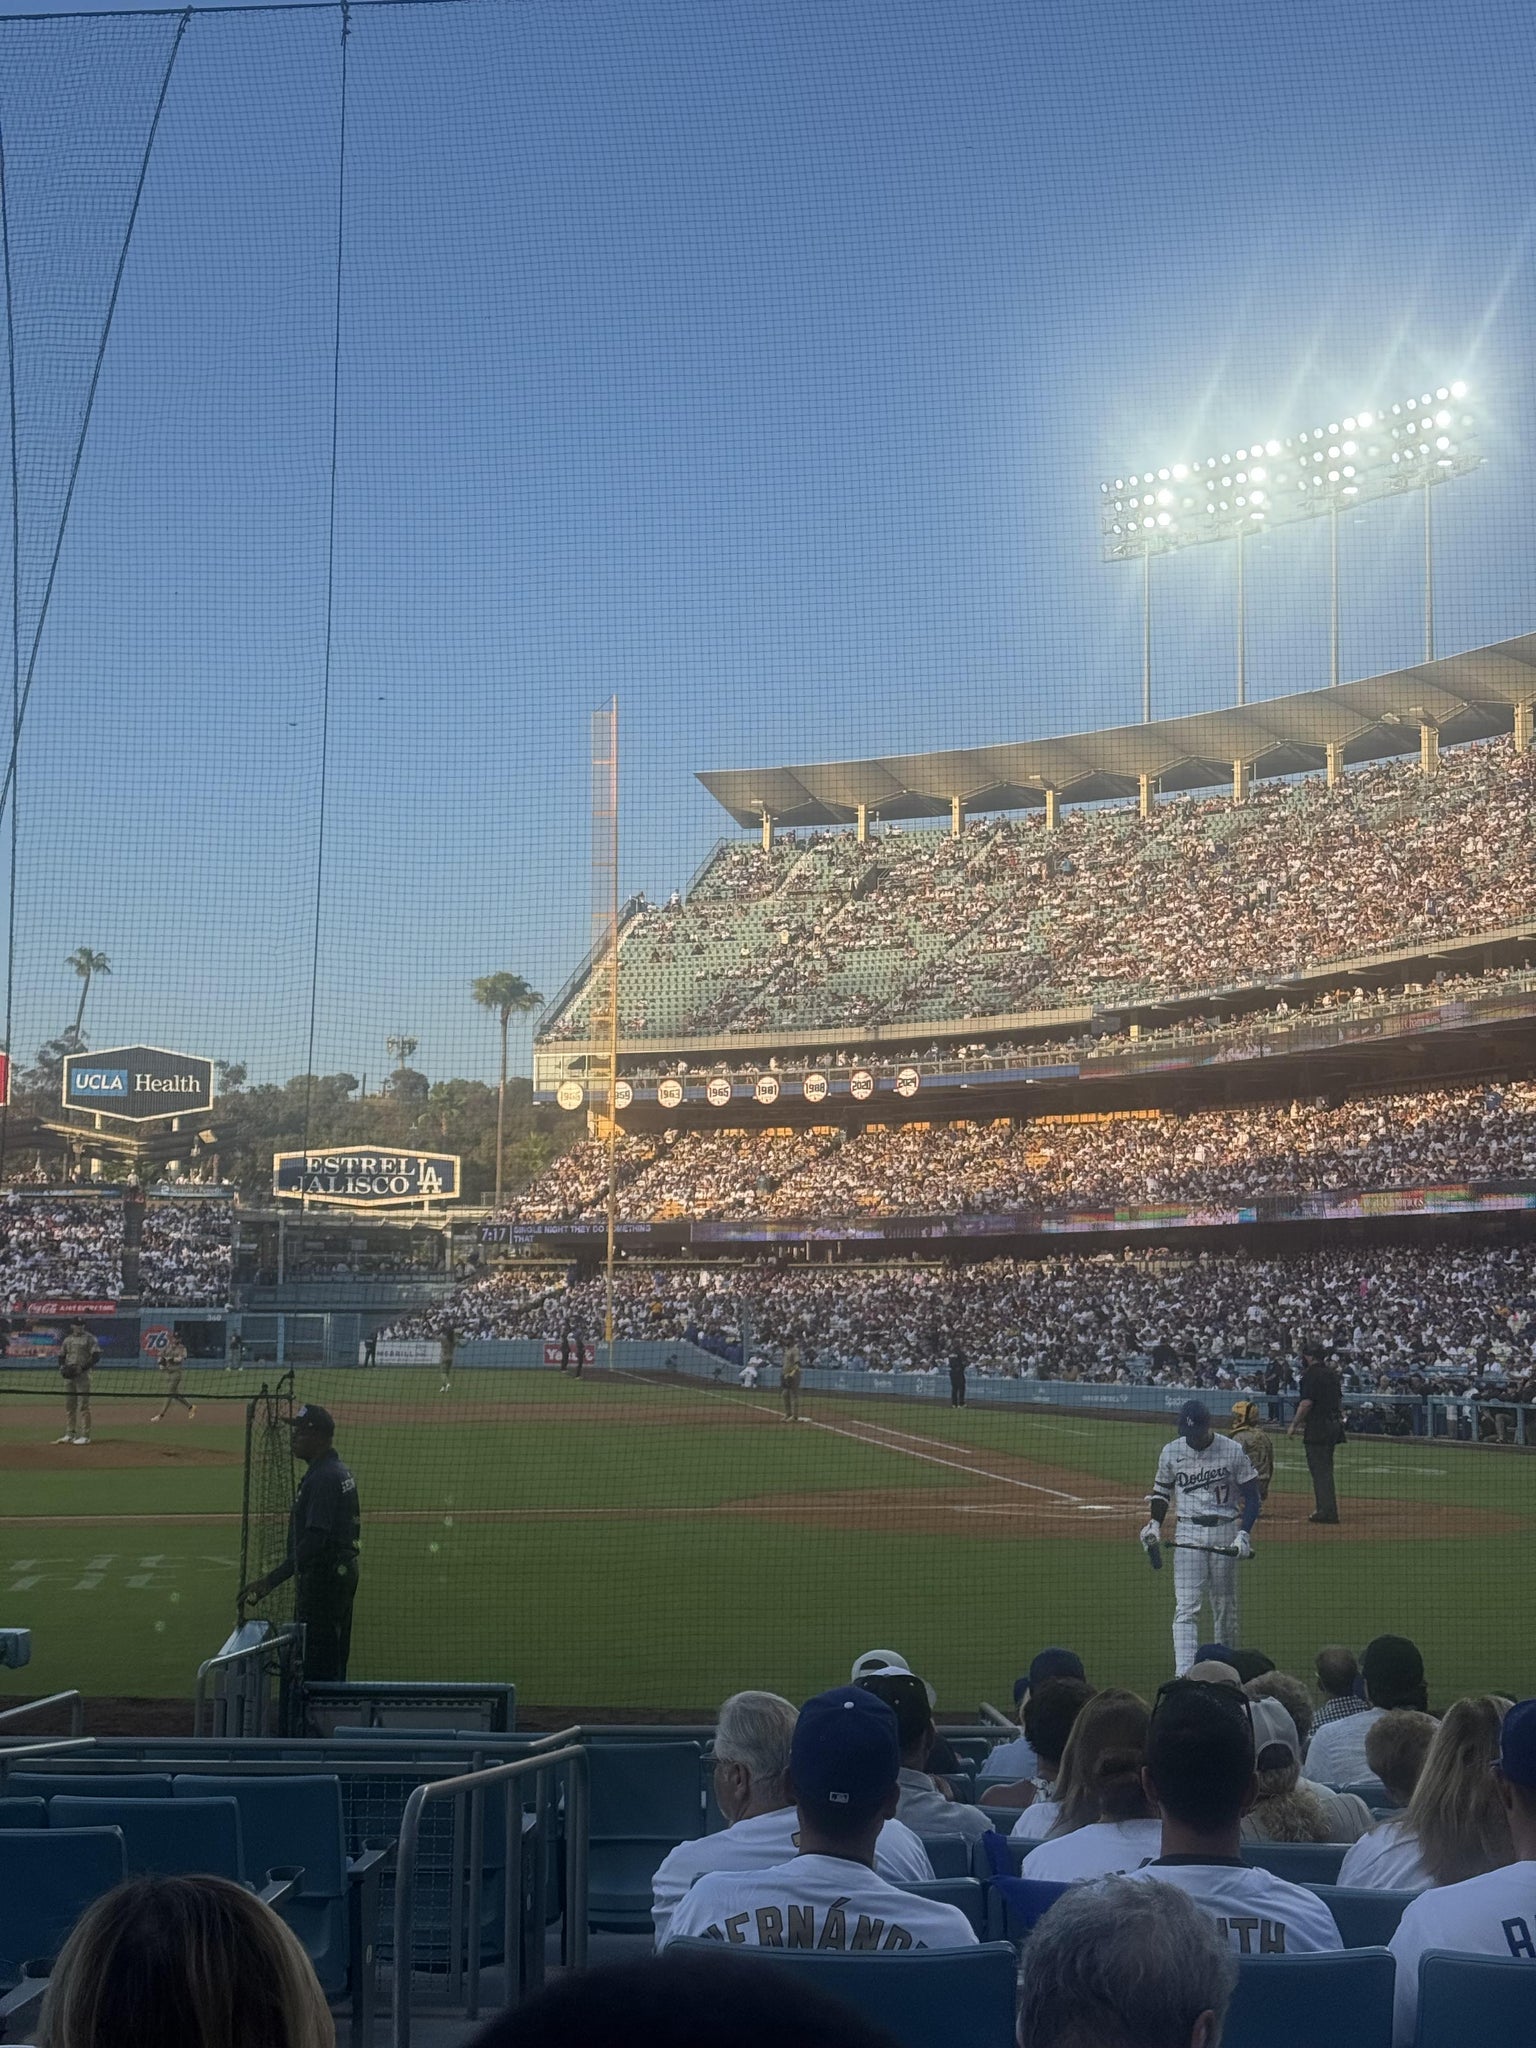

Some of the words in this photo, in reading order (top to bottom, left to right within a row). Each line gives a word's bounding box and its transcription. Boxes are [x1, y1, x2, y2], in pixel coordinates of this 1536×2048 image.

[75, 1073, 123, 1090] UCLA
[134, 1074, 201, 1093] Health
[805, 1083, 825, 1094] 1988
[852, 1081, 871, 1090] 2020
[660, 1088, 680, 1099] 1963
[708, 1087, 729, 1098] 1965
[757, 1085, 777, 1095] 1981
[292, 1176, 410, 1195] JALISCO
[481, 1227, 506, 1242] 7:17
[544, 1225, 569, 1234] NIGHT
[570, 1225, 591, 1234] THEY
[593, 1225, 605, 1233] DO
[513, 1234, 535, 1243] THAT
[145, 1330, 168, 1350] 76
[1176, 1467, 1232, 1491] Dodgers
[1214, 1485, 1229, 1505] 17
